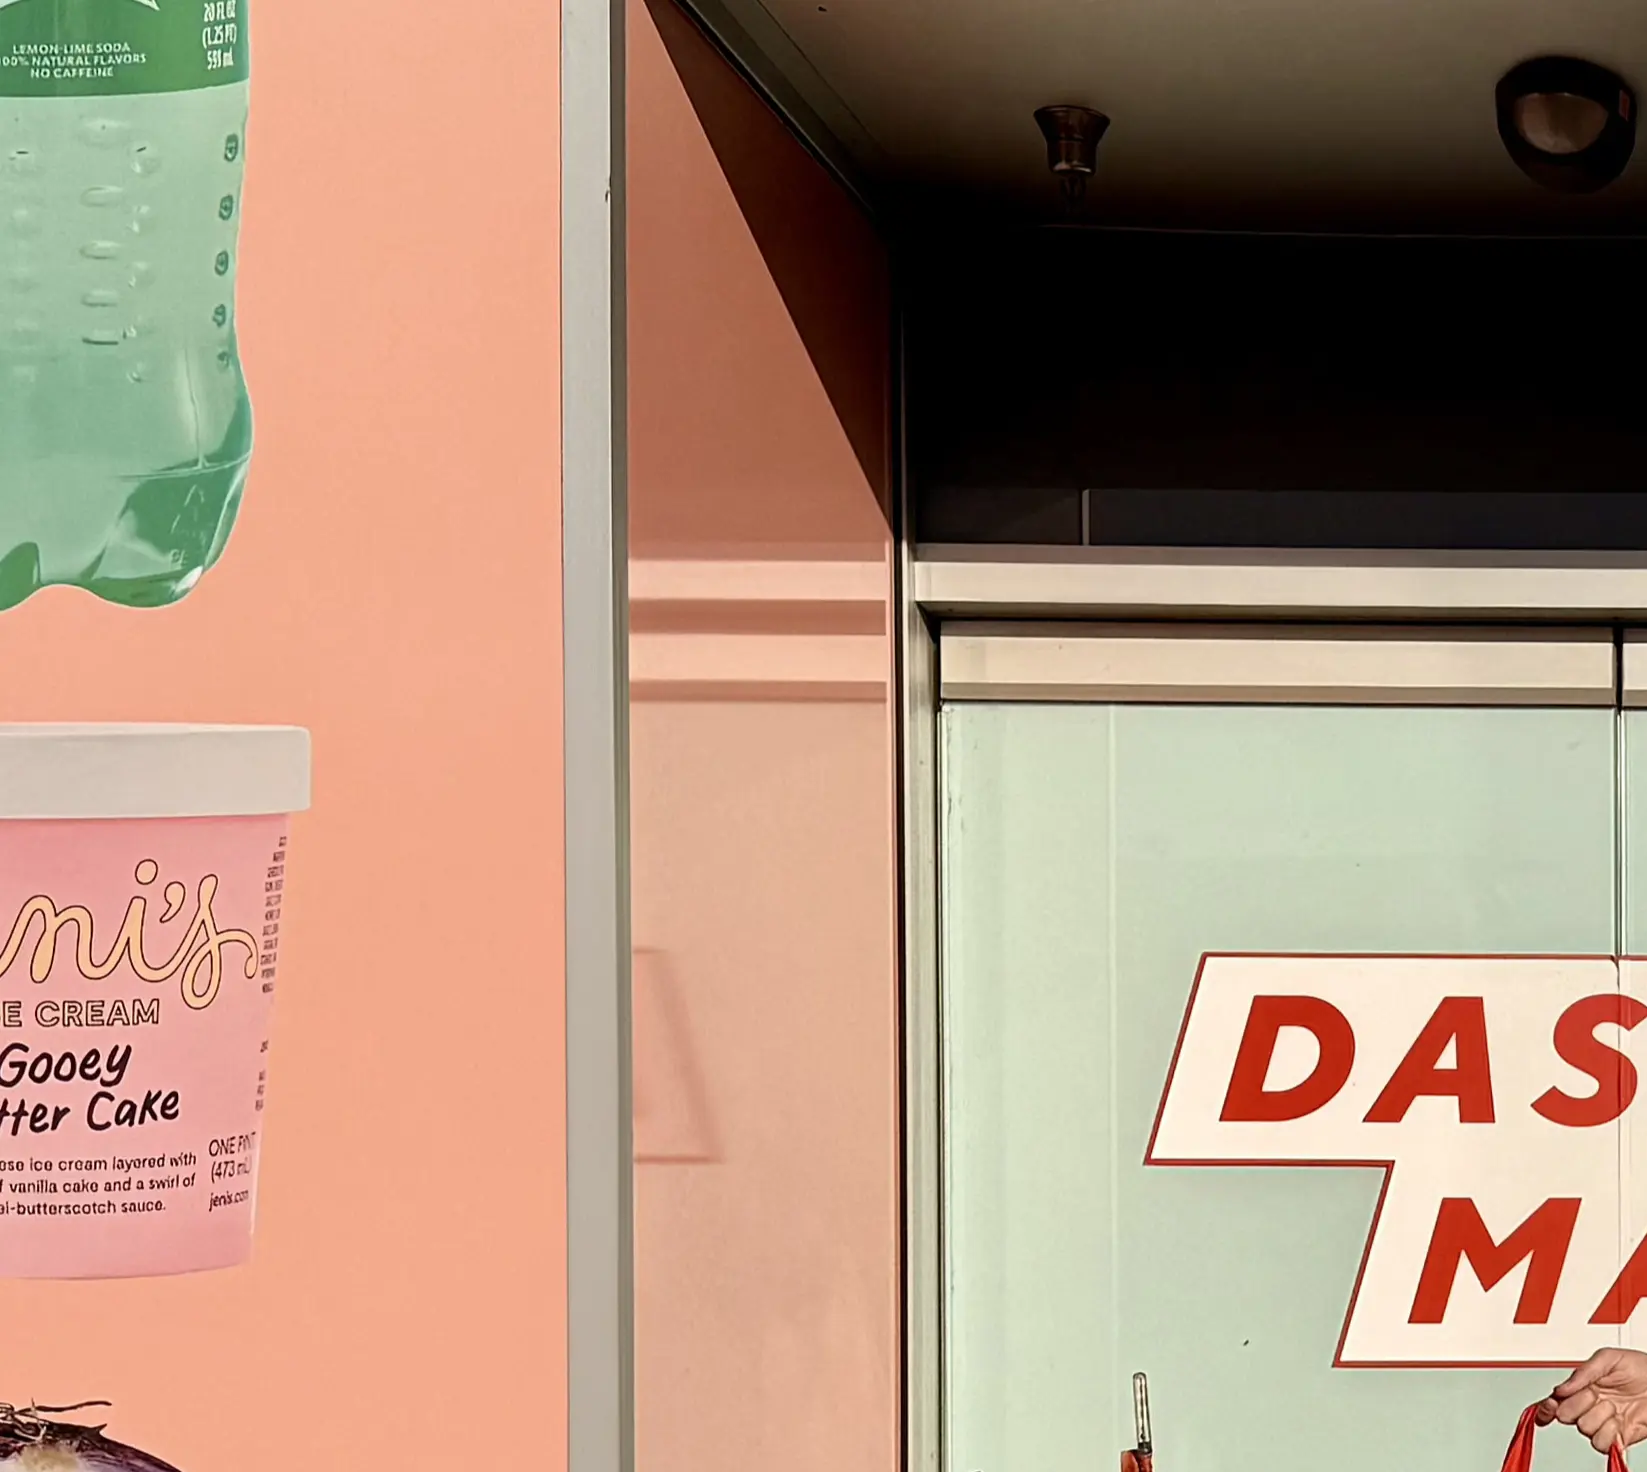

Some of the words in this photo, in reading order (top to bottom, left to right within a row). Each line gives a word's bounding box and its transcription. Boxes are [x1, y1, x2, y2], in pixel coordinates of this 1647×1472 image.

[96, 41, 131, 53] SODA
[0, 55, 29, 67] 00%
[32, 55, 92, 67] NATURAL
[94, 53, 147, 66] FLAVORS
[31, 67, 50, 78] NO
[53, 66, 114, 78] CAFFEINE
[0, 1001, 22, 1027] E
[35, 998, 160, 1027] CREAM
[0, 1042, 132, 1088] Gooey
[87, 1090, 179, 1131] Cake
[208, 1136, 236, 1157] ONE
[30, 1157, 53, 1171] ice
[58, 1159, 107, 1171] cream
[113, 1154, 165, 1173] layered
[170, 1152, 197, 1167] with
[9, 1179, 58, 1193] vanilla
[63, 1179, 98, 1193] cake
[104, 1177, 131, 1191] and
[136, 1180, 145, 1190] a
[149, 1175, 179, 1190] swirl
[183, 1173, 196, 1187] of
[121, 1200, 166, 1213] sauce.
